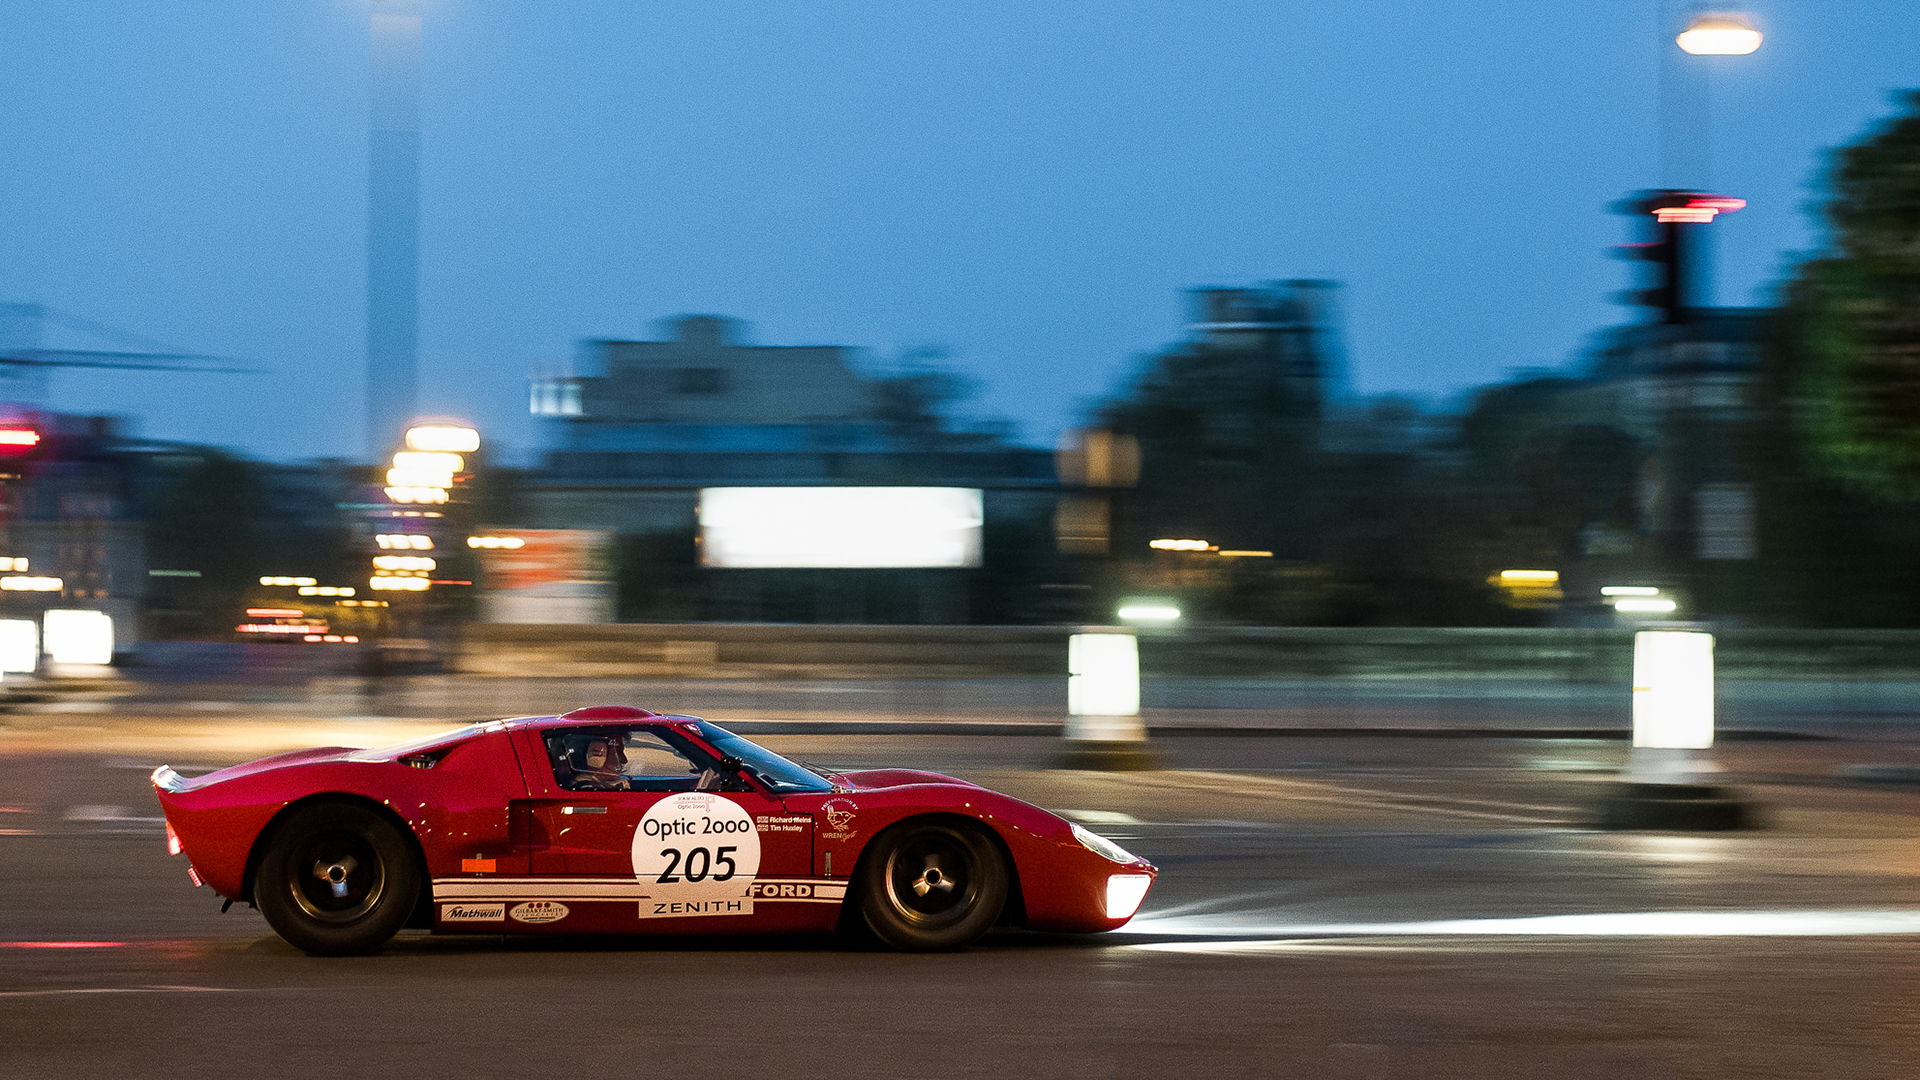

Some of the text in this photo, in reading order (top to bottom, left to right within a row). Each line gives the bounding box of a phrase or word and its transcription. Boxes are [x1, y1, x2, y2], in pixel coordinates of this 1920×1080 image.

[643, 816, 750, 841] Optic 2000
[782, 824, 804, 832] Huxley
[655, 845, 738, 884] 205
[749, 884, 812, 897] FORD
[450, 909, 504, 918] Mathwall
[653, 900, 741, 914] ZENITH
